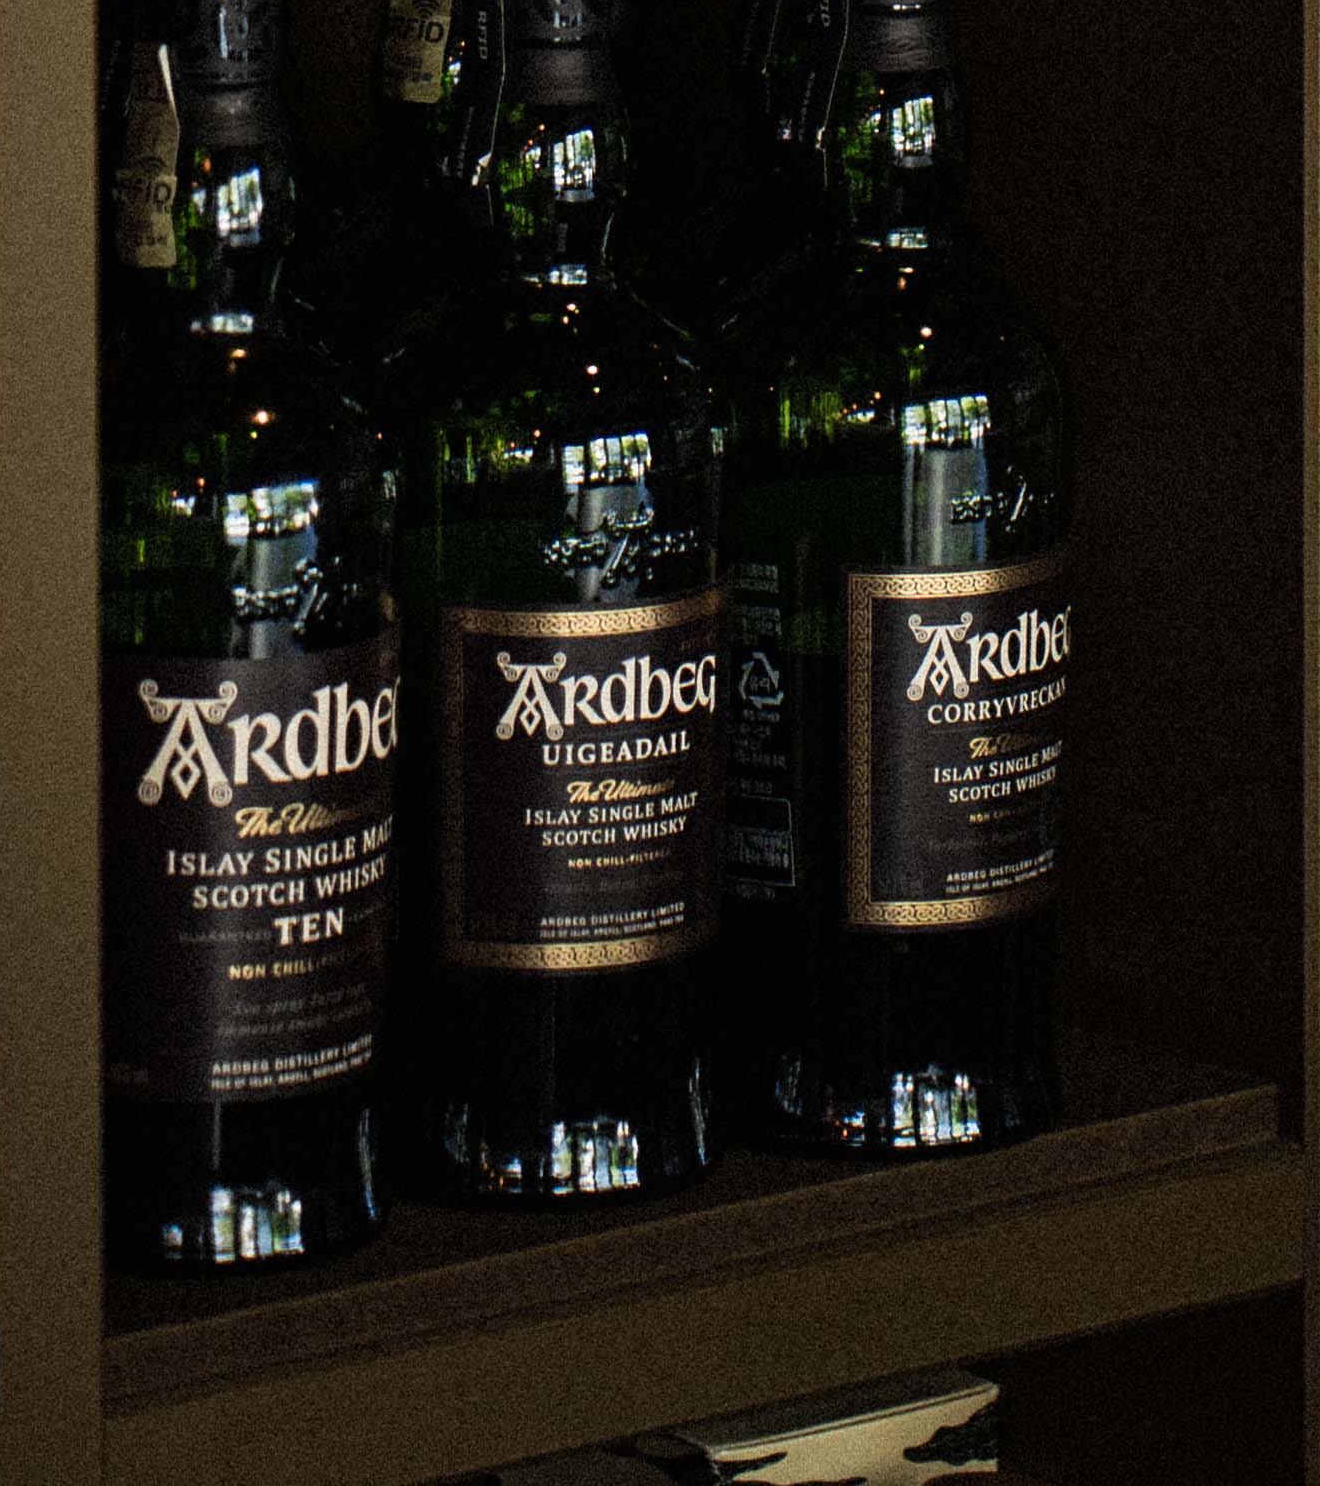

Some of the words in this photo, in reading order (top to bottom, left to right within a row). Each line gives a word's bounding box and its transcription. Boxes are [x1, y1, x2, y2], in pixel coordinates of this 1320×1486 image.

[541, 729, 691, 767] UIGEADAIL
[968, 736, 998, 760] The
[933, 766, 984, 784] ISLAY
[988, 752, 1039, 779] SINGLE
[948, 781, 1011, 804] SCOTCH
[1015, 765, 1057, 793] WHISKY
[524, 808, 581, 826] ISLAY
[587, 801, 655, 824] SINGLE
[660, 790, 699, 816] MALT
[566, 780, 599, 804] The
[234, 806, 282, 839] The
[541, 828, 616, 847] SCOTCH
[623, 816, 688, 842] WHISKY
[167, 849, 254, 876] ISLAY
[264, 836, 357, 874] SINGLE
[192, 879, 305, 910] SCOTCH
[314, 853, 388, 900] WHISKY
[272, 907, 345, 946] TEN
[229, 963, 266, 980] NON
